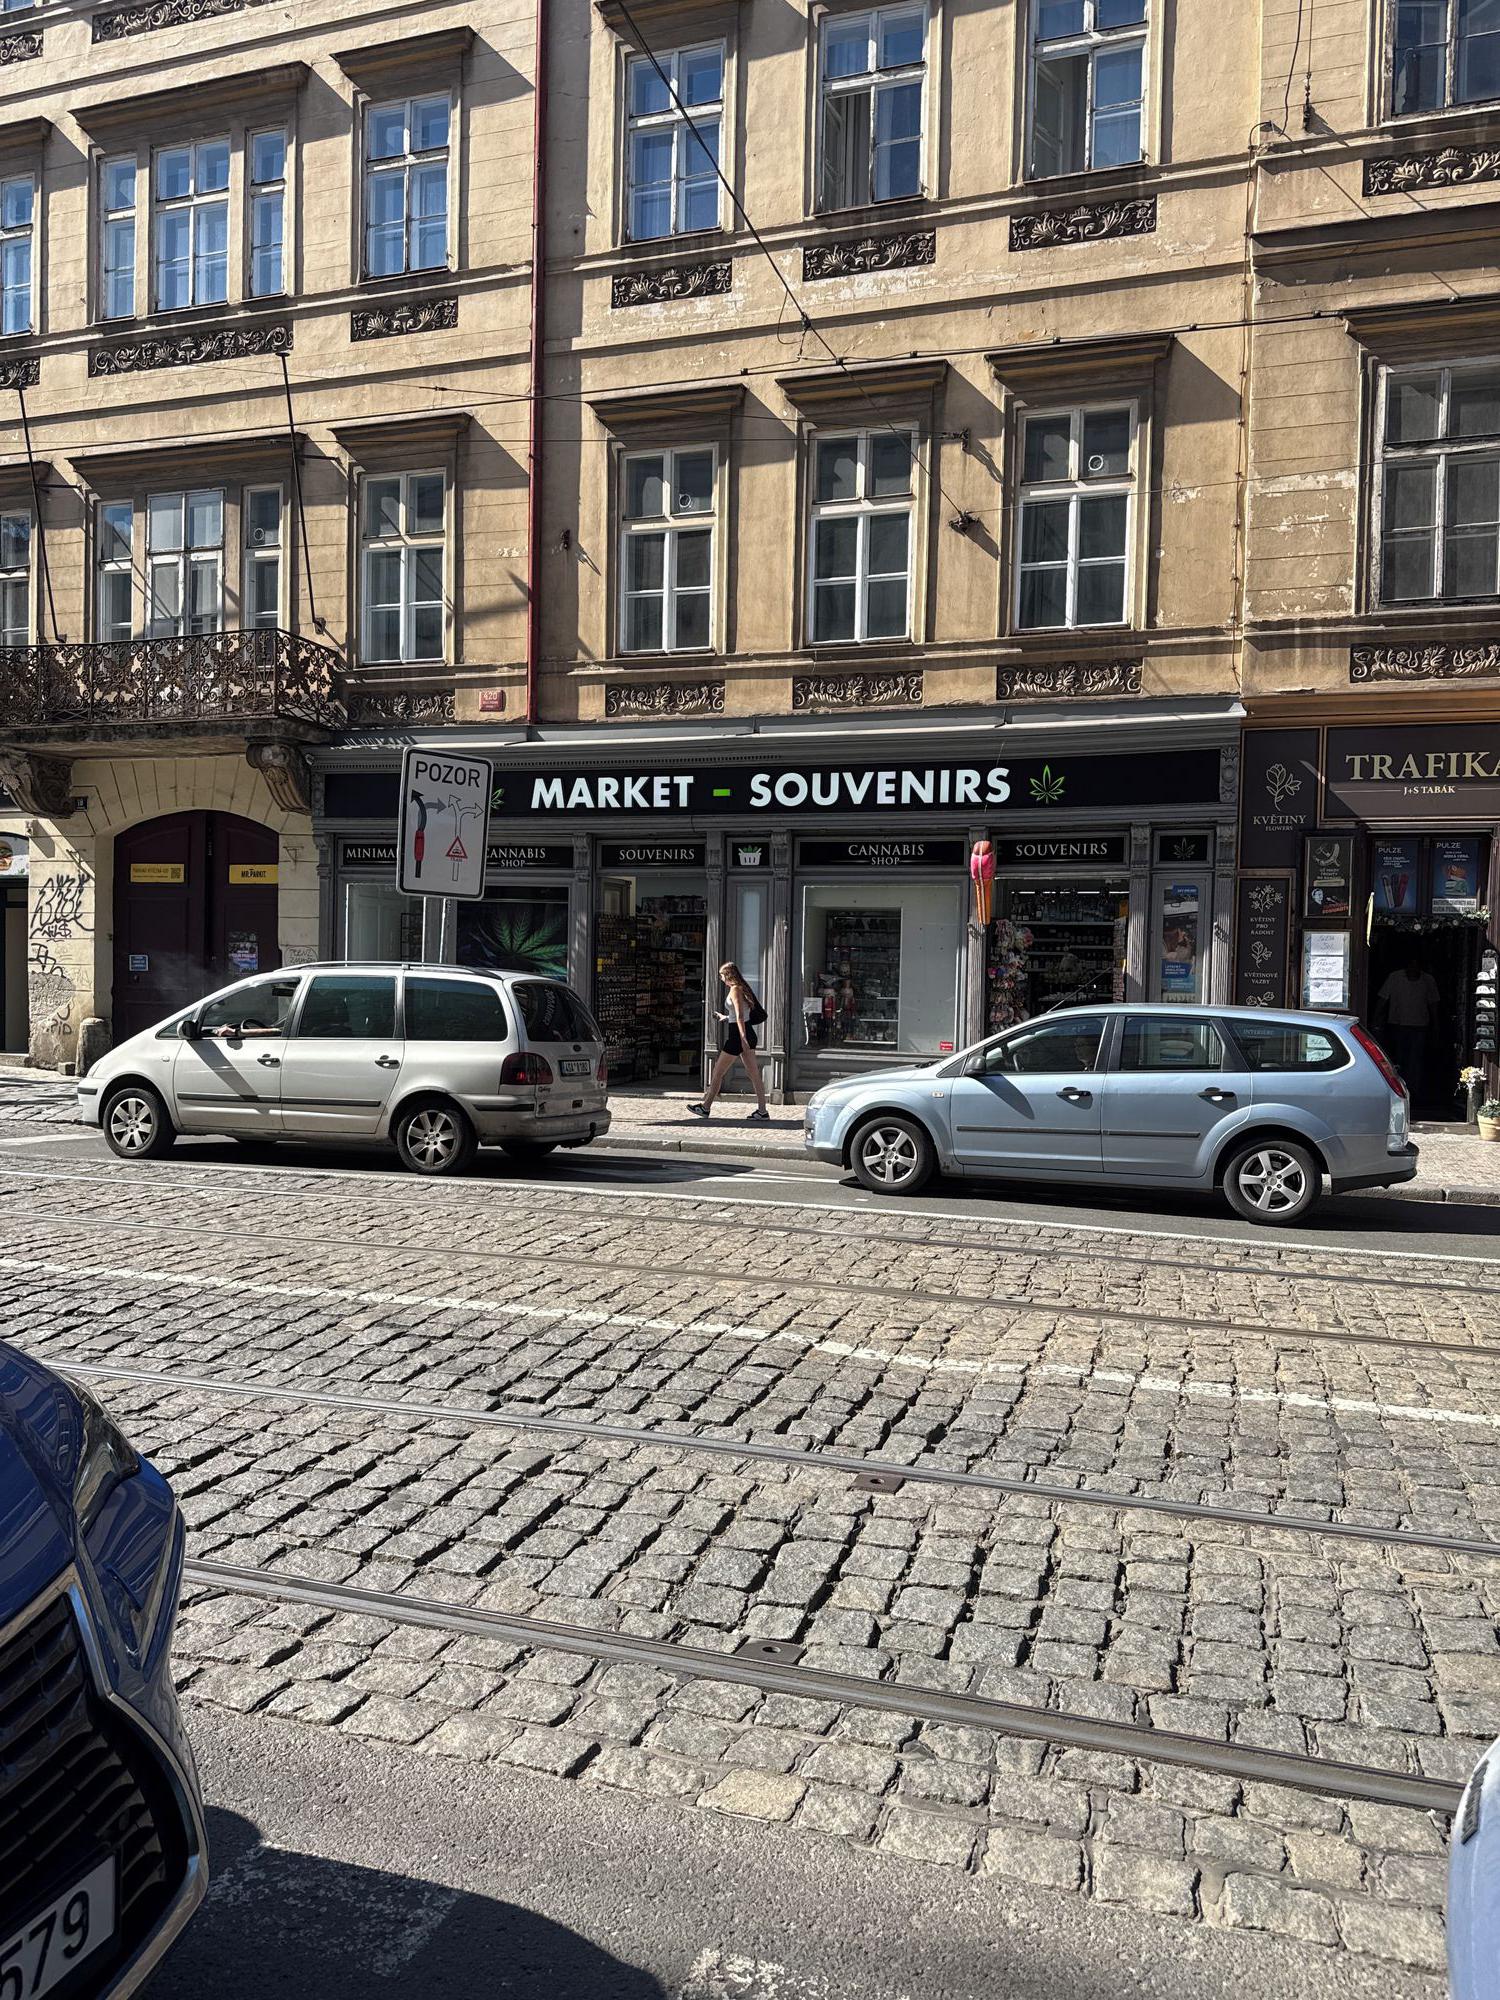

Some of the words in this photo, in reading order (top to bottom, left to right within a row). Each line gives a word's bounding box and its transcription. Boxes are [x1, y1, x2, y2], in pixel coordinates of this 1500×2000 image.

[415, 760, 481, 788] POZOR
[530, 775, 694, 809] MARKET
[749, 767, 1011, 807] SOUVENIRS
[1403, 785, 1419, 796] J+S
[1420, 784, 1456, 794] TABÁK
[1252, 814, 1307, 825] KVĚTINY
[346, 847, 396, 859] MINIMA
[619, 849, 695, 861] SOUVENIRS
[848, 844, 925, 857] CANNABIS
[1015, 842, 1108, 857] SOUVENIRS
[500, 859, 526, 868] SHOP
[871, 856, 900, 866] SHOP
